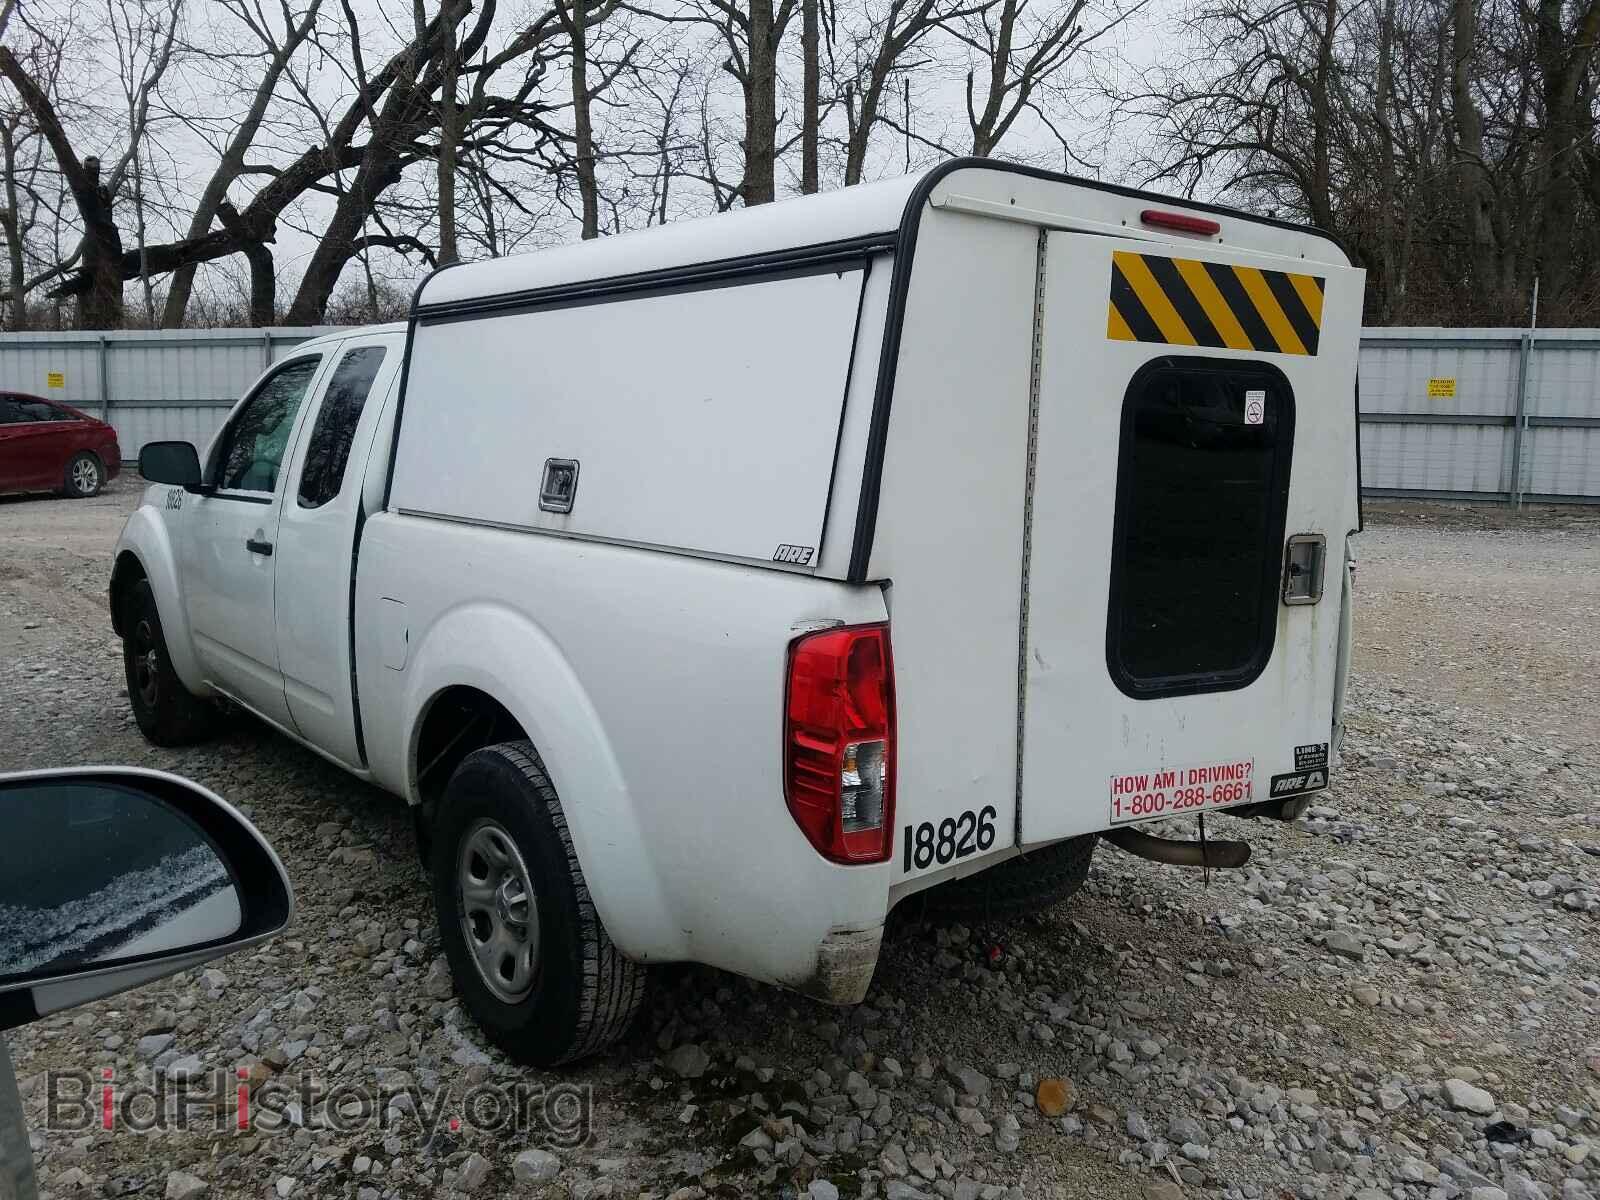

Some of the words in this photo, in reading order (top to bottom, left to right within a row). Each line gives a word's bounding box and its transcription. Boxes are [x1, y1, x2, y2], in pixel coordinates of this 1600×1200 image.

[773, 544, 814, 565] ARE
[1113, 775, 1149, 795] HOW
[1153, 772, 1175, 790] AM
[1180, 770, 1184, 786] I
[1188, 762, 1252, 786] DRIVING?
[1113, 781, 1252, 817] 1-800-288-6661
[904, 805, 997, 873] 18826
